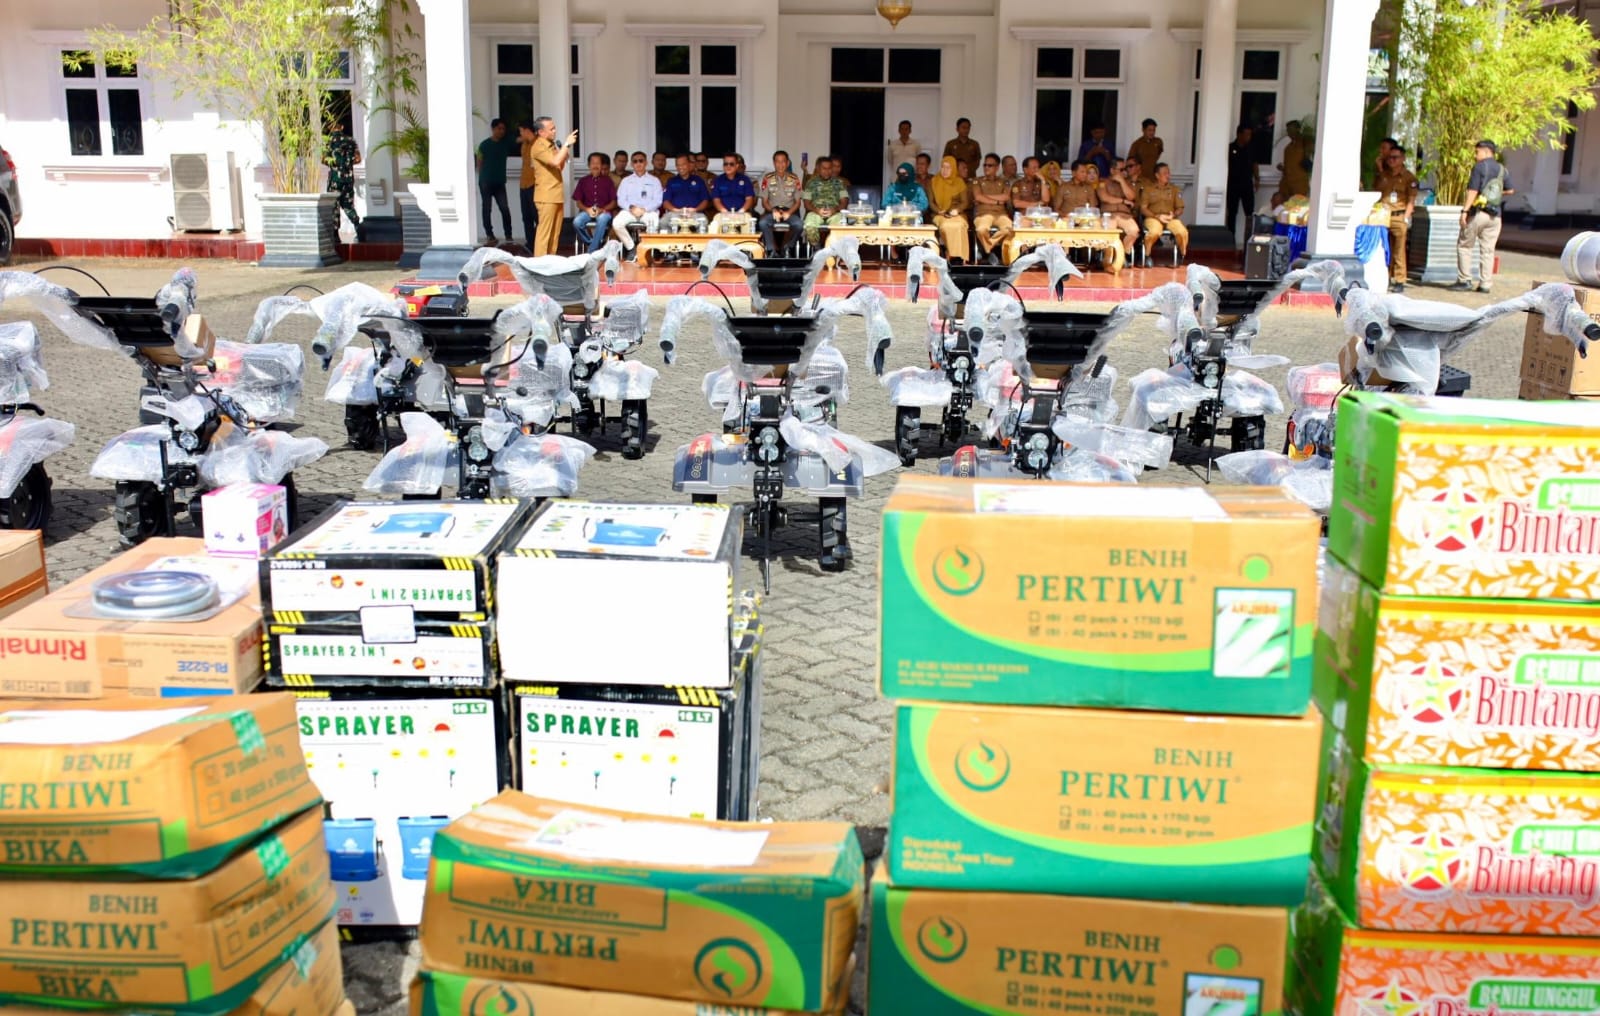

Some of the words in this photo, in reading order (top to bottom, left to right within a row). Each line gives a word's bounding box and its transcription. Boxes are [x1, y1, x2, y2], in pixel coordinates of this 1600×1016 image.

[1499, 502, 1600, 554] Bintan
[1109, 549, 1187, 567] BENIH
[371, 589, 375, 600] 1
[382, 589, 395, 600] IN
[400, 589, 406, 600] 2
[412, 589, 472, 601] SPRAYER
[1017, 574, 1184, 605] PERTIWI
[0, 637, 87, 661] Rinnai
[283, 645, 345, 657] SPRAYER
[350, 645, 356, 657] 2
[362, 645, 375, 657] IN
[380, 645, 386, 657] 1
[471, 703, 486, 714] LT
[696, 712, 711, 722] LT
[1476, 676, 1600, 737] Bintang
[299, 715, 414, 736] SPRAYER
[527, 712, 639, 738] SPRAYER
[62, 752, 133, 772] BENIH
[1154, 748, 1232, 768] BENIH
[0, 780, 130, 810] ERTIWI
[1059, 770, 1229, 804] PERTIWI
[4, 839, 89, 862] BIKA
[1474, 846, 1597, 905] Bintang
[513, 877, 597, 907] BIKA
[88, 894, 158, 914] BENIH
[11, 918, 158, 950] PERTIWI
[469, 919, 618, 961] PERTIWI
[1085, 930, 1160, 953] BENIH
[465, 952, 534, 975] BENIH
[996, 946, 1157, 986] PERTIWI
[38, 975, 121, 1001] BIKA
[1479, 984, 1531, 1006] BENIH
[1533, 985, 1597, 1009] UNGGUL
